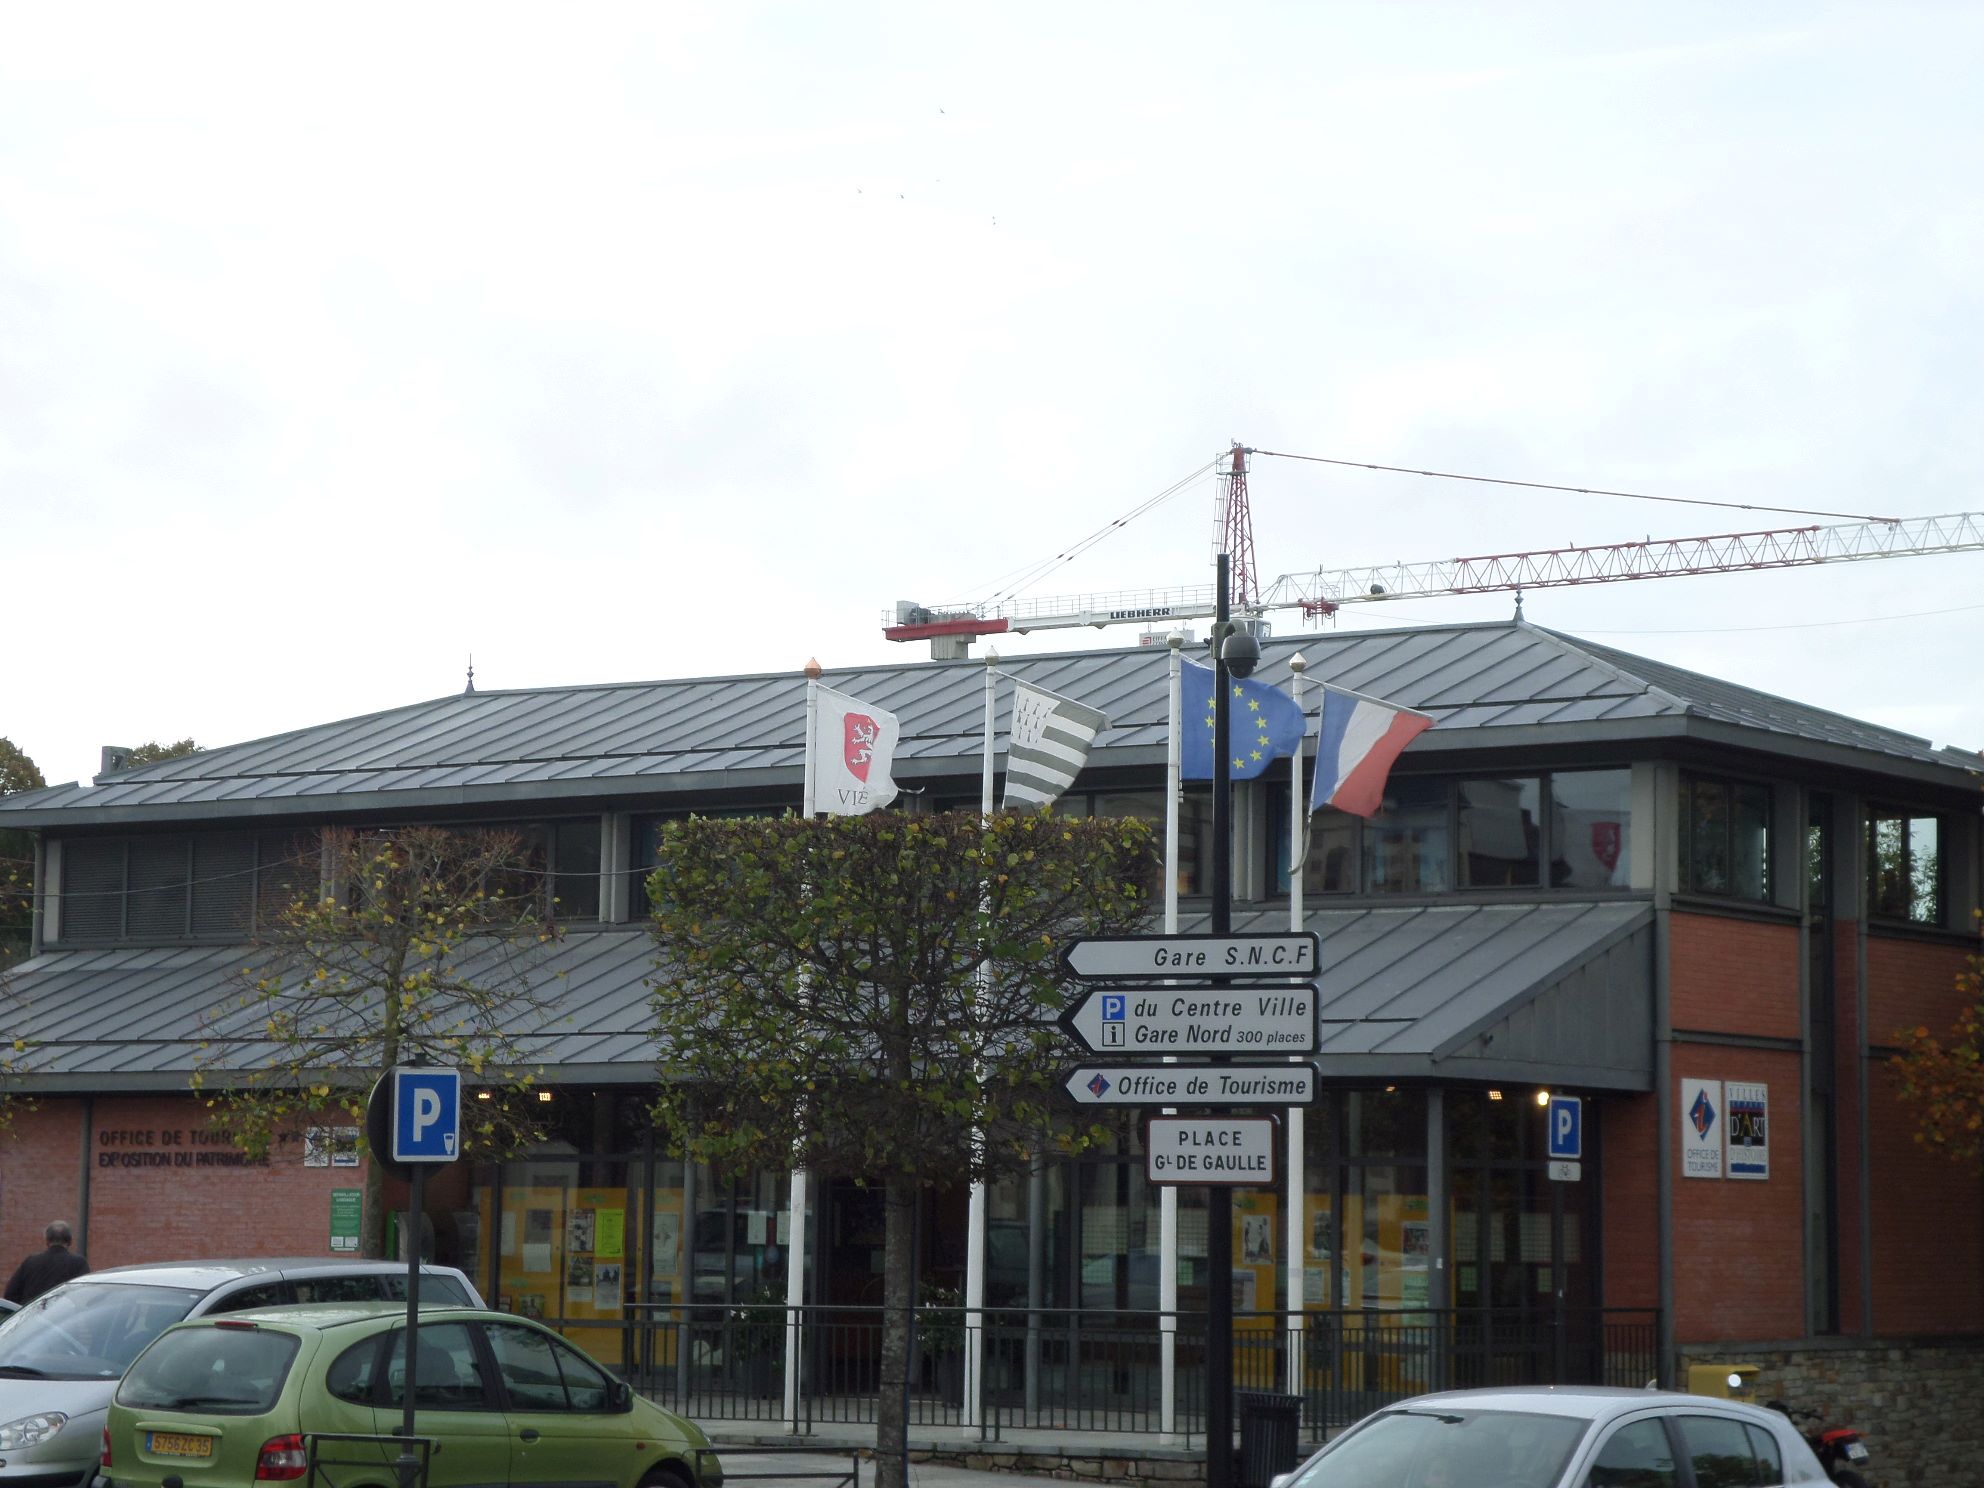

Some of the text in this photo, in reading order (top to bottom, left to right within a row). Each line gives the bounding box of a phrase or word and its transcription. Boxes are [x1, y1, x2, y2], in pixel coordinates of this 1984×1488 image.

[1110, 607, 1170, 619] LIEBHERR
[1154, 945, 1308, 966] Gare S.N.C.F
[1106, 997, 1307, 1019] P du Centre Ville
[1135, 1025, 1179, 1043] Gare
[1186, 1024, 1232, 1043] Nord
[1236, 1031, 1263, 1043] 300
[1266, 1030, 1306, 1046] places
[1118, 1075, 1306, 1095] Office de Tourisme
[413, 1087, 441, 1142] P
[1731, 1112, 1766, 1137] D'ART
[1558, 1108, 1573, 1145] P
[100, 1129, 155, 1146] OFFICE
[162, 1129, 182, 1146] DE
[1178, 1130, 1242, 1146] PLACE
[98, 1151, 171, 1167] EXPOSITION
[174, 1151, 193, 1167] DU
[1176, 1154, 1197, 1170] DE
[1203, 1155, 1266, 1171] GAULLE
[1687, 1148, 1719, 1160] OFFICE DE
